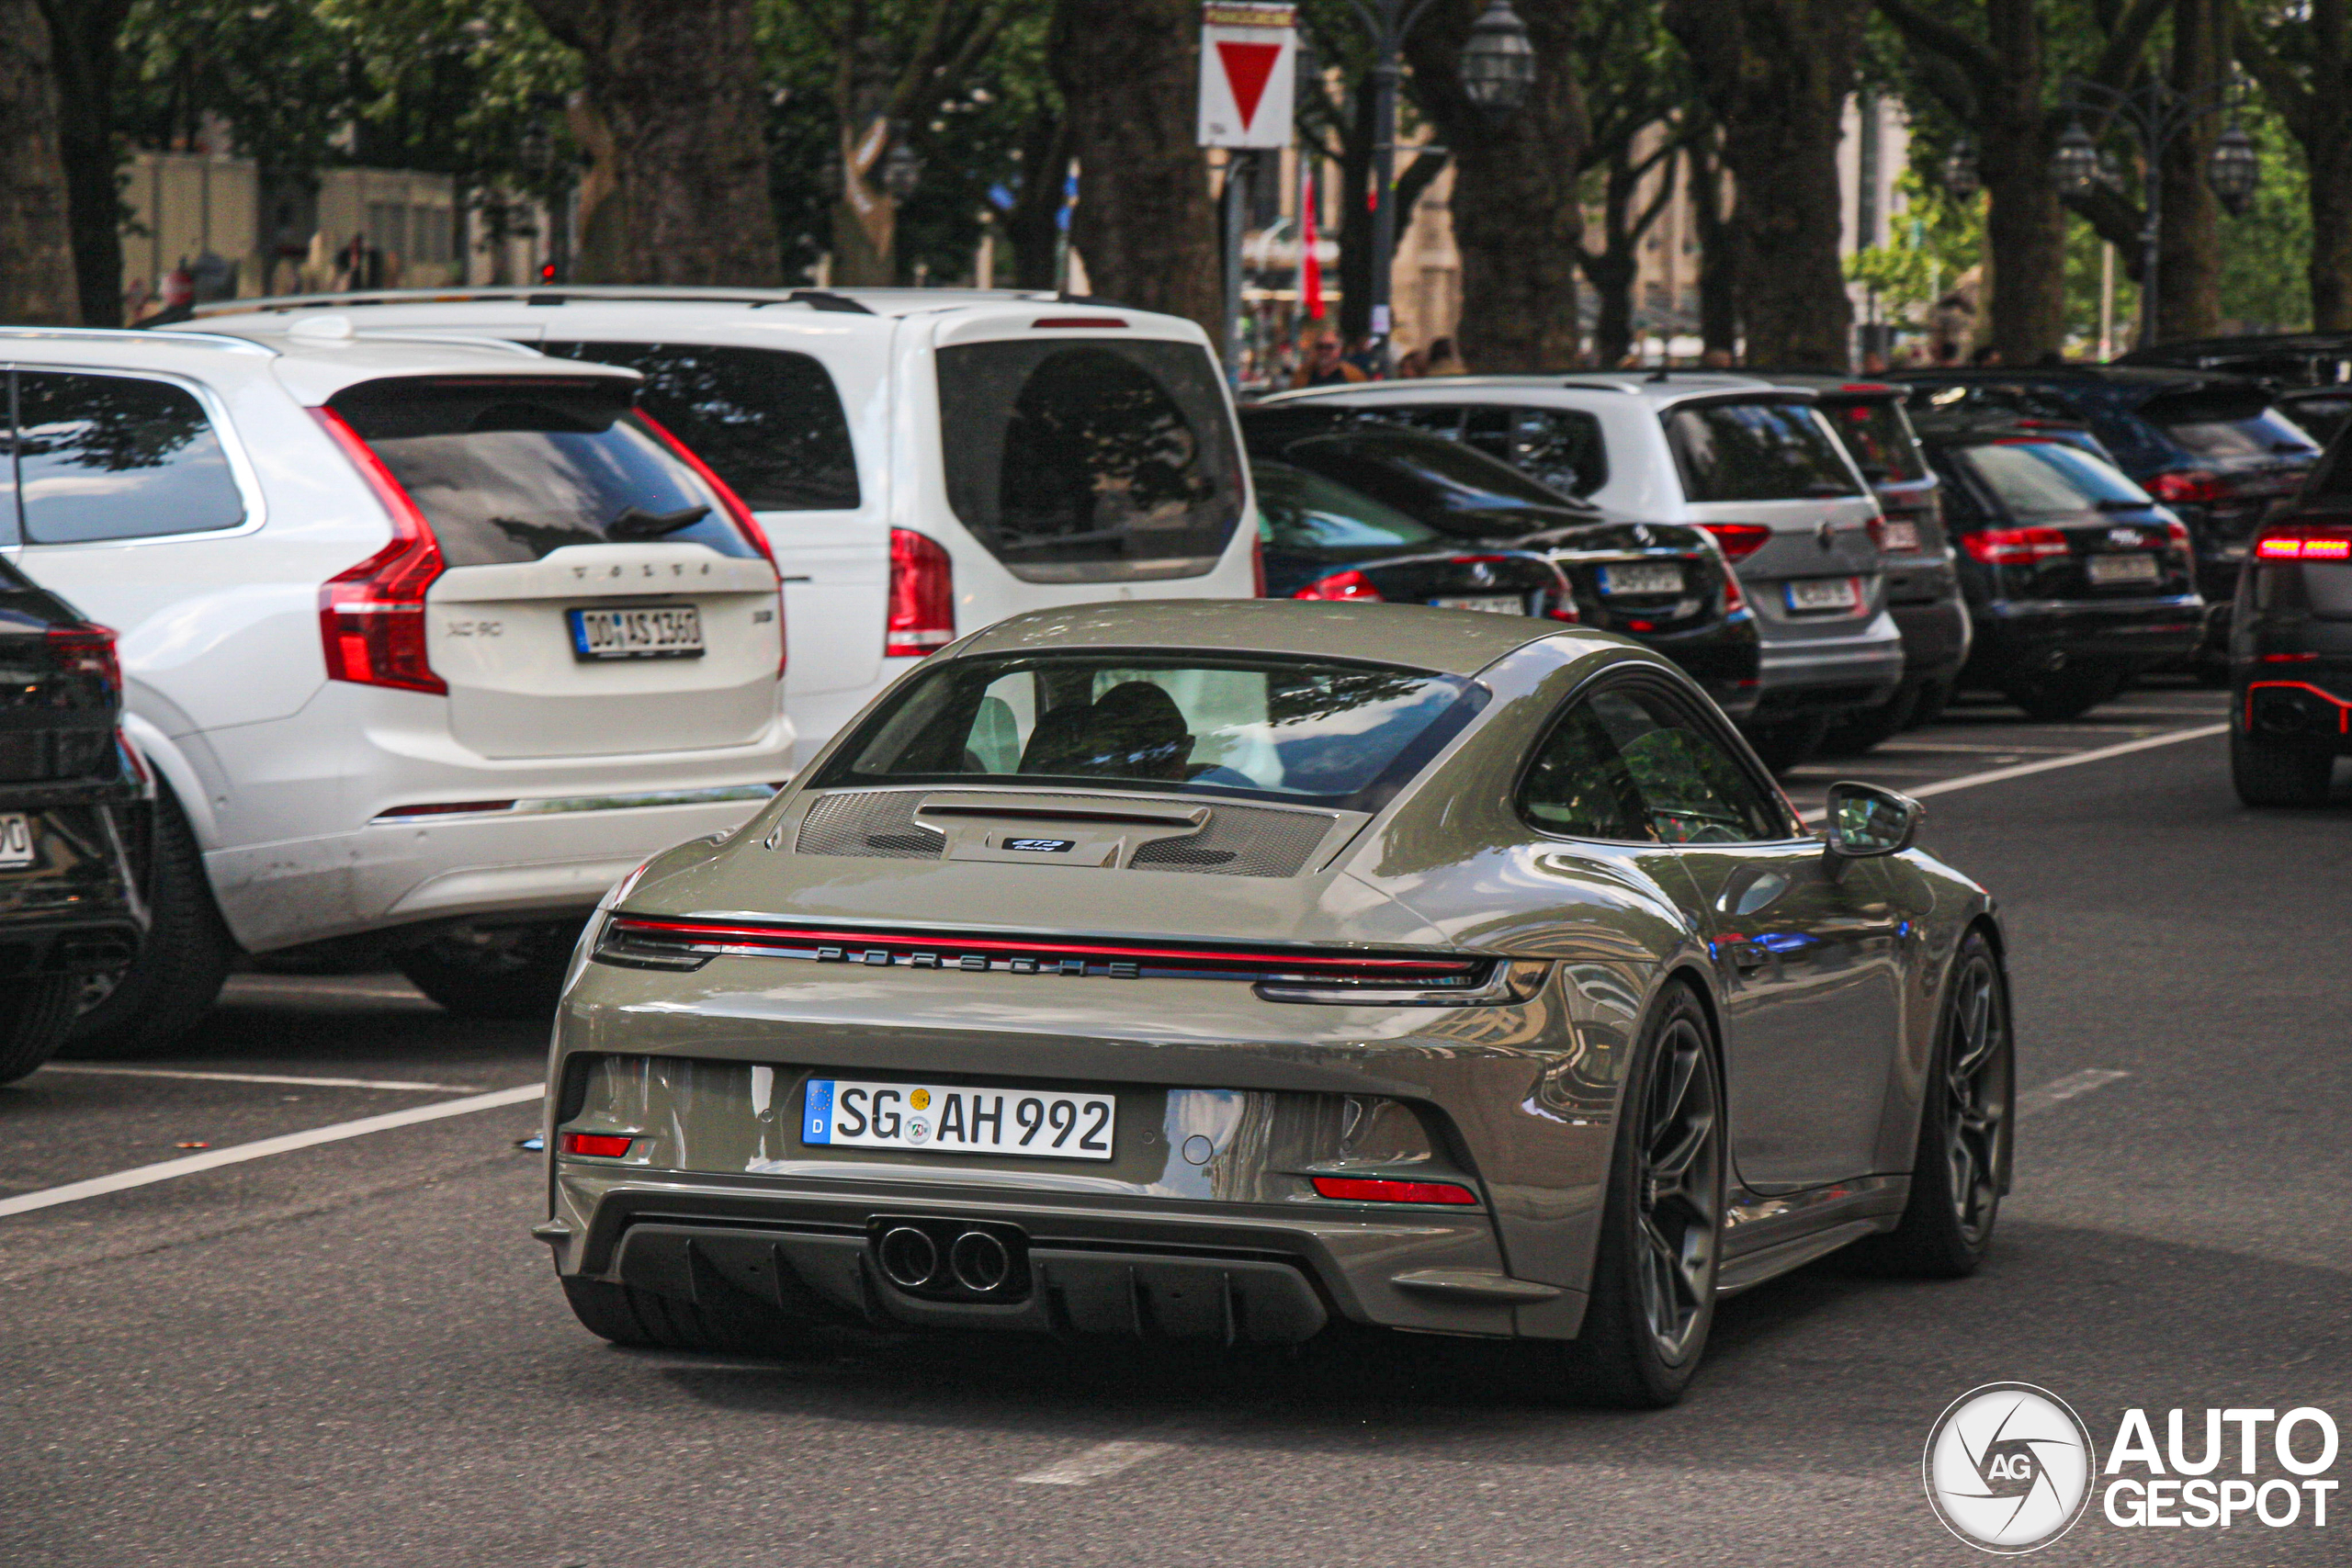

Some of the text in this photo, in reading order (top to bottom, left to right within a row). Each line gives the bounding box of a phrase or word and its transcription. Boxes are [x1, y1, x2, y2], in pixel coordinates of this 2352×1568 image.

[572, 564, 709, 579] VOLVO
[816, 946, 1140, 979] PORSCHE
[812, 1088, 1110, 1151] D SG AH 992
